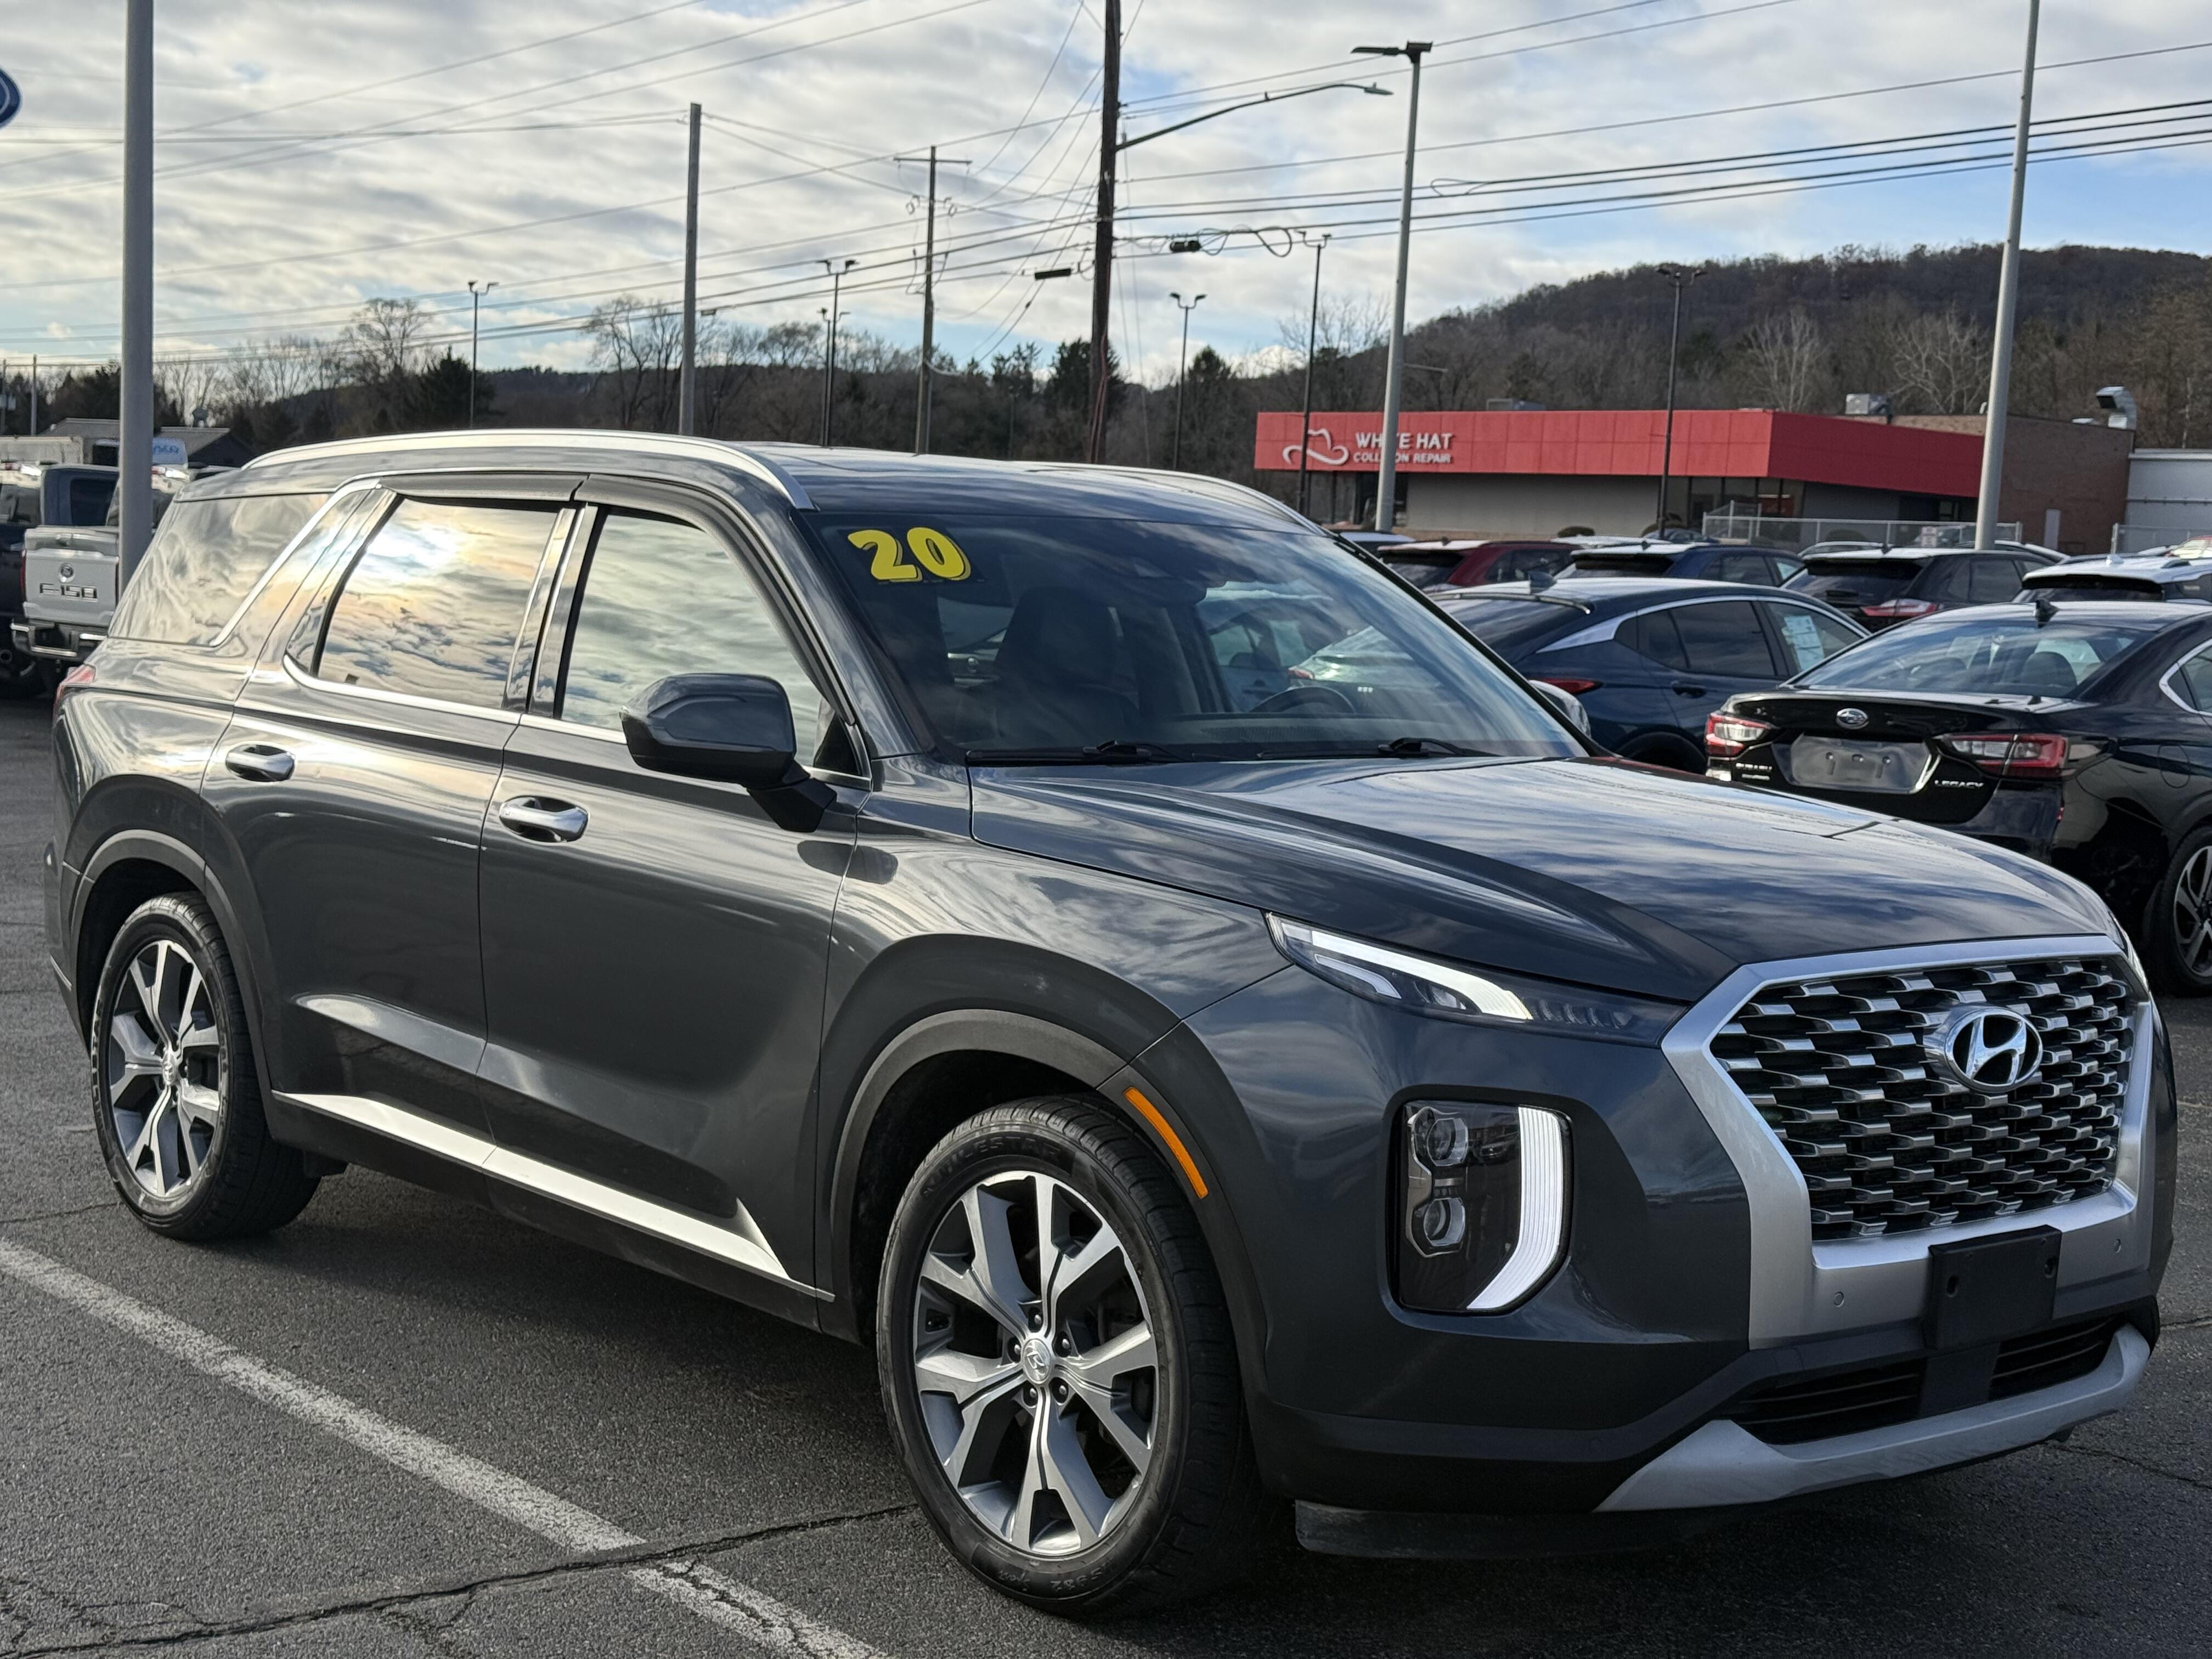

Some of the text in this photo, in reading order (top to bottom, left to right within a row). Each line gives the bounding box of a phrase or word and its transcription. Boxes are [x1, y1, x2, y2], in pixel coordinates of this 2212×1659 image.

[1356, 432, 1453, 449] WHE HAT
[1413, 453, 1451, 463] REPAIR
[848, 527, 972, 582] 20
[40, 583, 98, 602] F-150
[1934, 780, 1984, 789] LEGACY
